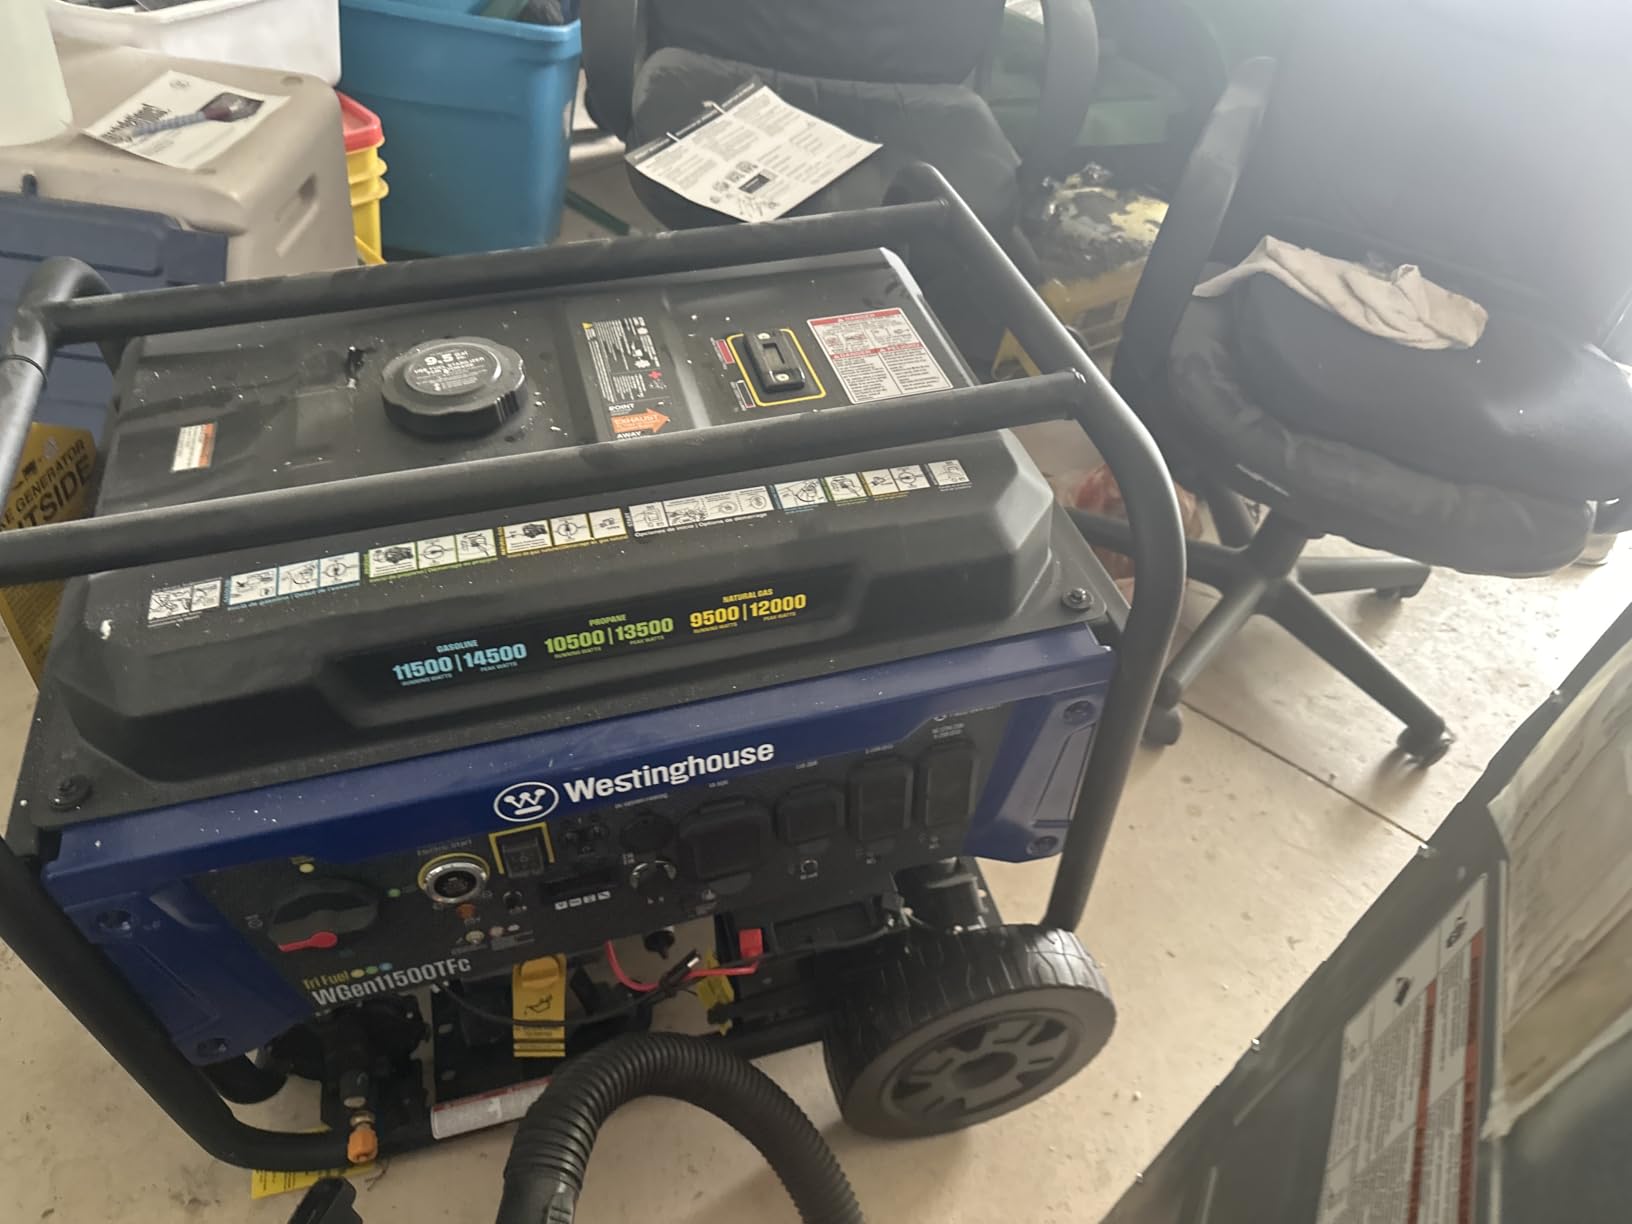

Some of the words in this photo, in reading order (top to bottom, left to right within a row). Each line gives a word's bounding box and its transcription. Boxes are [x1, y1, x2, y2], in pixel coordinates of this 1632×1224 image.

[424, 353, 454, 366] 9.5
[616, 430, 642, 439] AWAY
[16, 439, 84, 513] GENERATOR
[18, 453, 91, 528] TSIDE
[722, 591, 756, 604] NATURAL
[757, 588, 774, 600] GAS
[588, 613, 626, 628] PROPANE
[689, 605, 740, 628] 9500
[749, 593, 807, 617] 12000
[435, 639, 479, 653] GASOLINE
[544, 629, 606, 654] 10500
[615, 617, 674, 641] 13500
[392, 656, 454, 681] 11500
[463, 643, 527, 668] 14500
[564, 742, 775, 803] Westinghouse
[320, 970, 350, 986] Fuel
